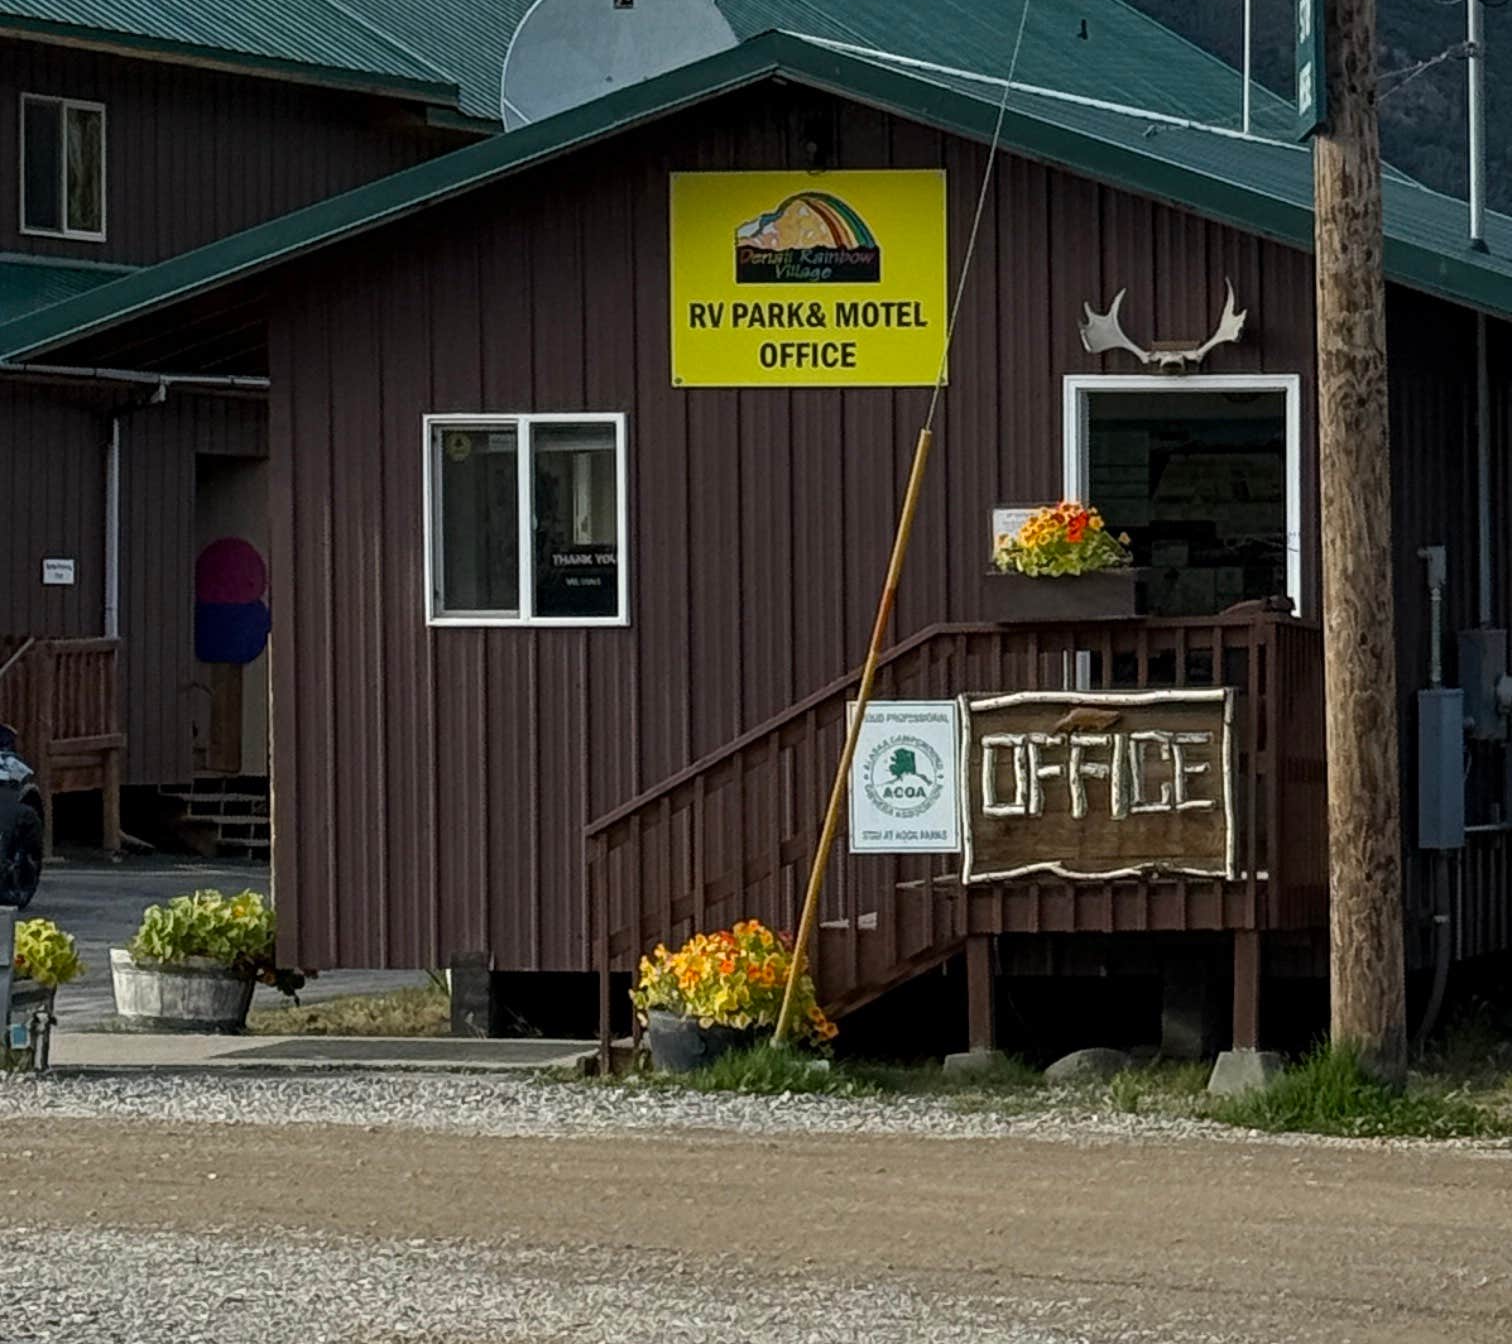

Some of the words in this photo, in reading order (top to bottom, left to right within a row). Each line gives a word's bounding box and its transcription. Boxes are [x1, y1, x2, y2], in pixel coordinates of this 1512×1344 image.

[800, 247, 876, 266] Rainbow
[775, 264, 832, 281] Village
[689, 302, 724, 329] RV
[835, 301, 929, 328] MOTEL
[759, 341, 857, 368] OFFICE
[982, 730, 1217, 820] OFFICE
[882, 786, 927, 799] ACOA
